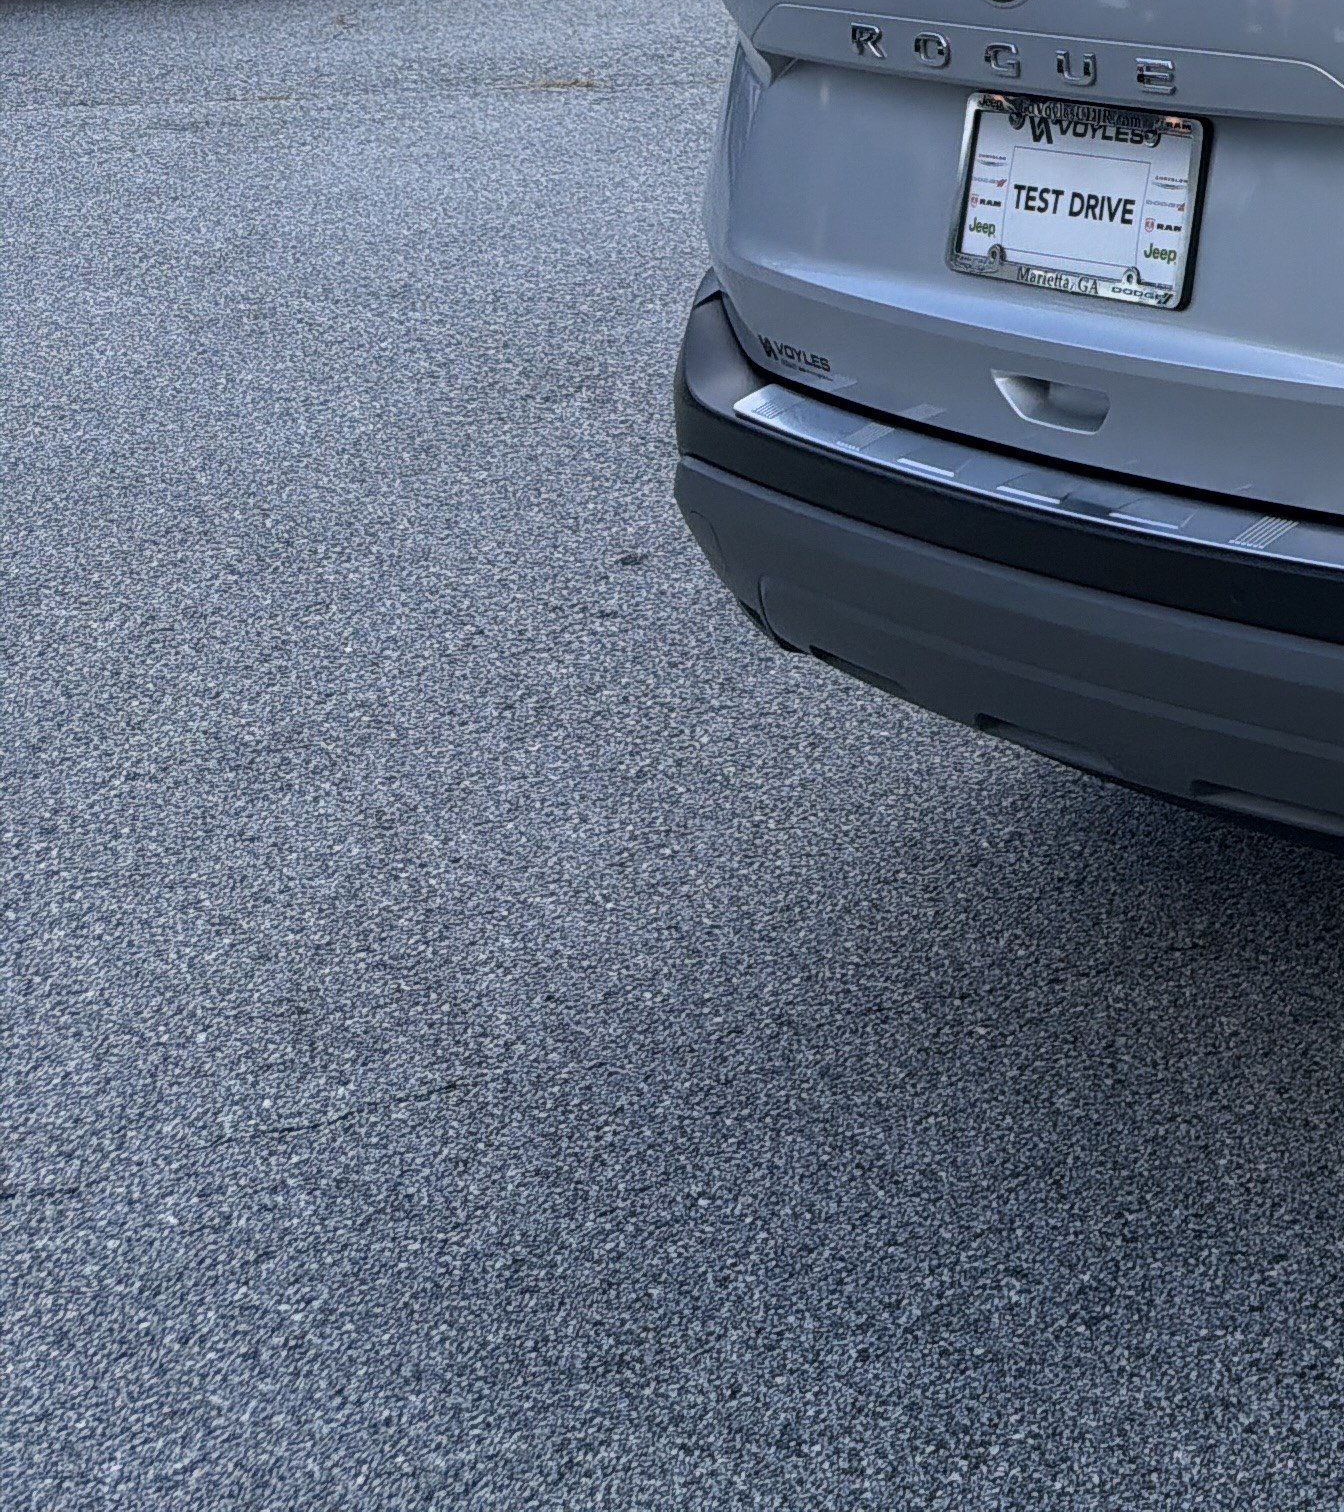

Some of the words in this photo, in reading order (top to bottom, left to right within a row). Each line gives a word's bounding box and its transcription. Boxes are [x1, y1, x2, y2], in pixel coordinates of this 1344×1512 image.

[850, 21, 1177, 96] ROGUE
[1164, 121, 1192, 131] RAM
[979, 198, 1002, 207] RAM
[1013, 183, 1065, 215] TEST
[1068, 191, 1136, 225] DRIVE
[968, 216, 996, 238] Jeep
[1143, 242, 1178, 265] Jeep
[1016, 267, 1075, 291] Marietta,
[1078, 276, 1099, 295] GA
[773, 340, 832, 373] VOYLES
